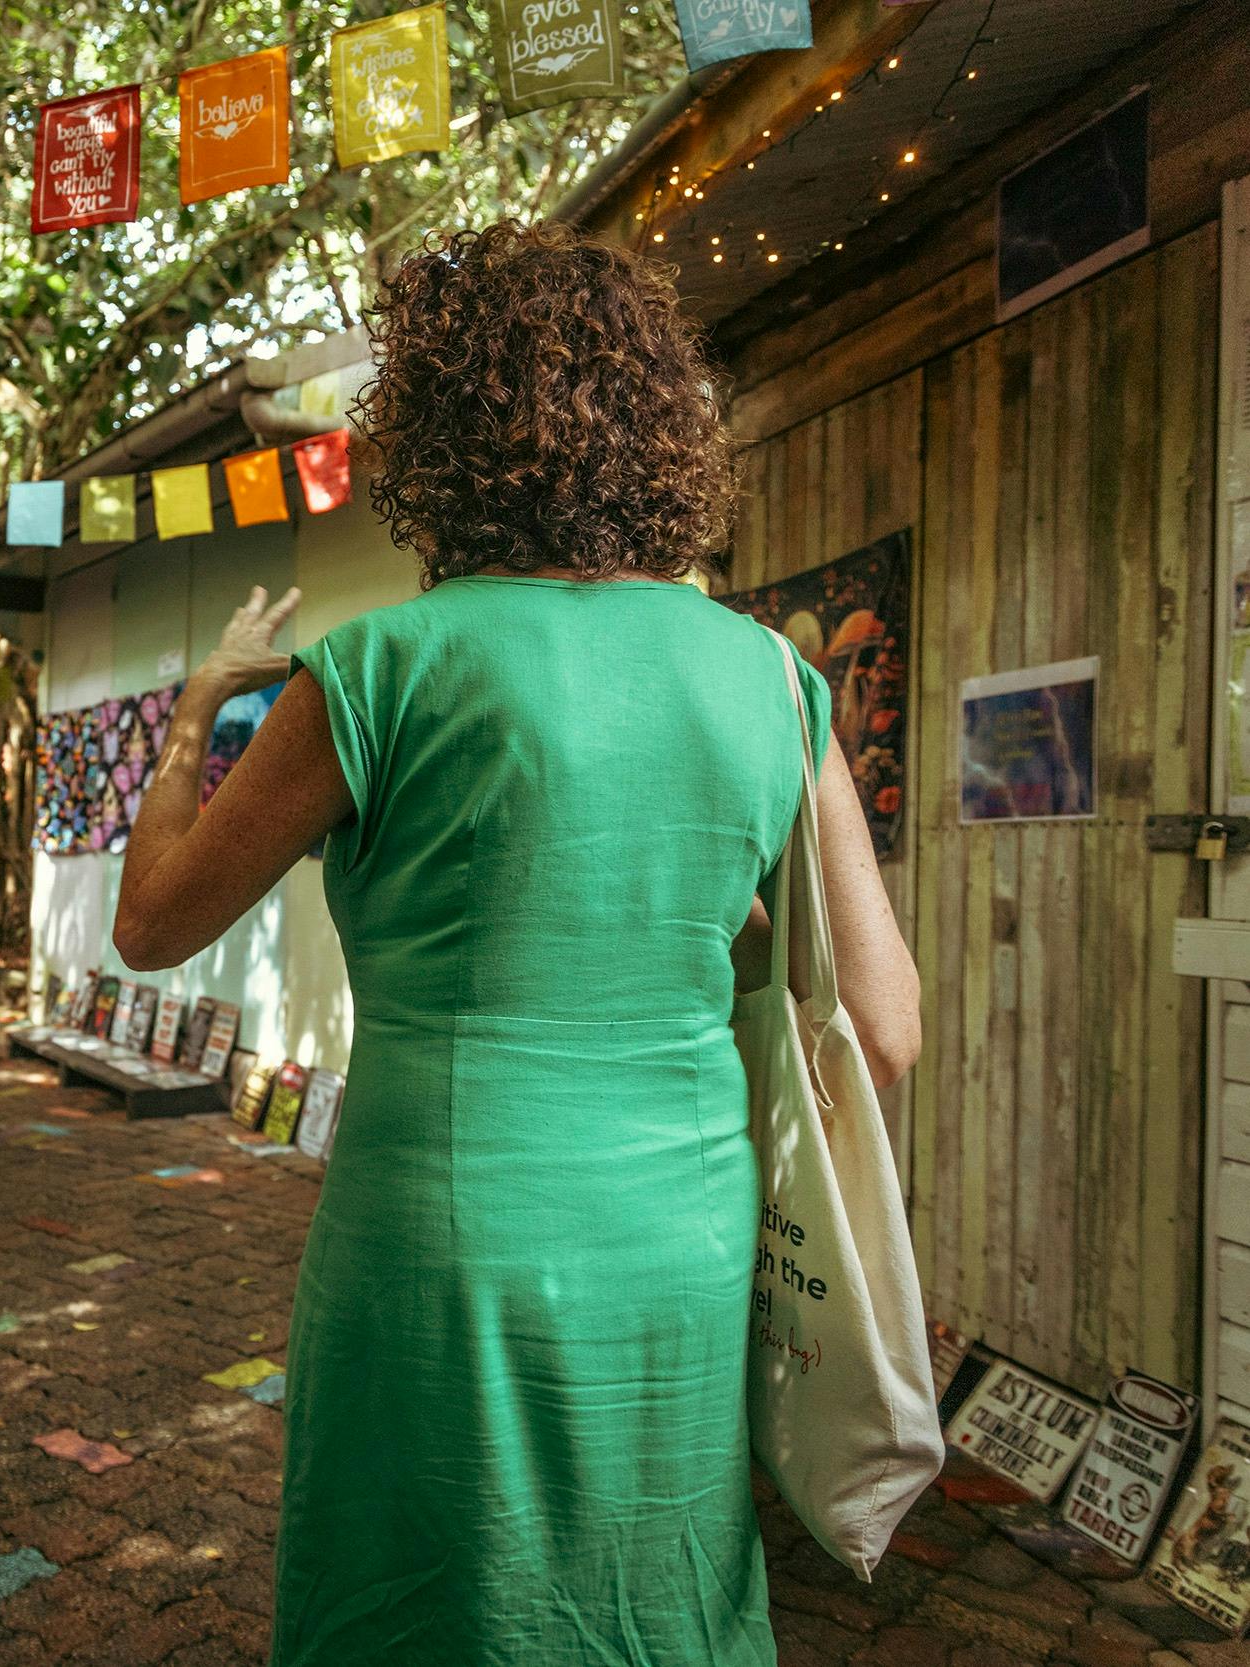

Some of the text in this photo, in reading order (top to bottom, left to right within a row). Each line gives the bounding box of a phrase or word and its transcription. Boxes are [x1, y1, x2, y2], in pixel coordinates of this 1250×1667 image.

[511, 10, 605, 63] blessed
[56, 112, 117, 141] beautiful
[198, 93, 264, 127] believe
[64, 134, 104, 155] wings
[92, 148, 116, 170] fly
[54, 167, 115, 196] without
[67, 194, 97, 218] you
[761, 1198, 805, 1247] itive
[781, 1257, 827, 1301] the
[988, 1371, 1095, 1440] ASYLUM
[1069, 1499, 1141, 1553] TARGET
